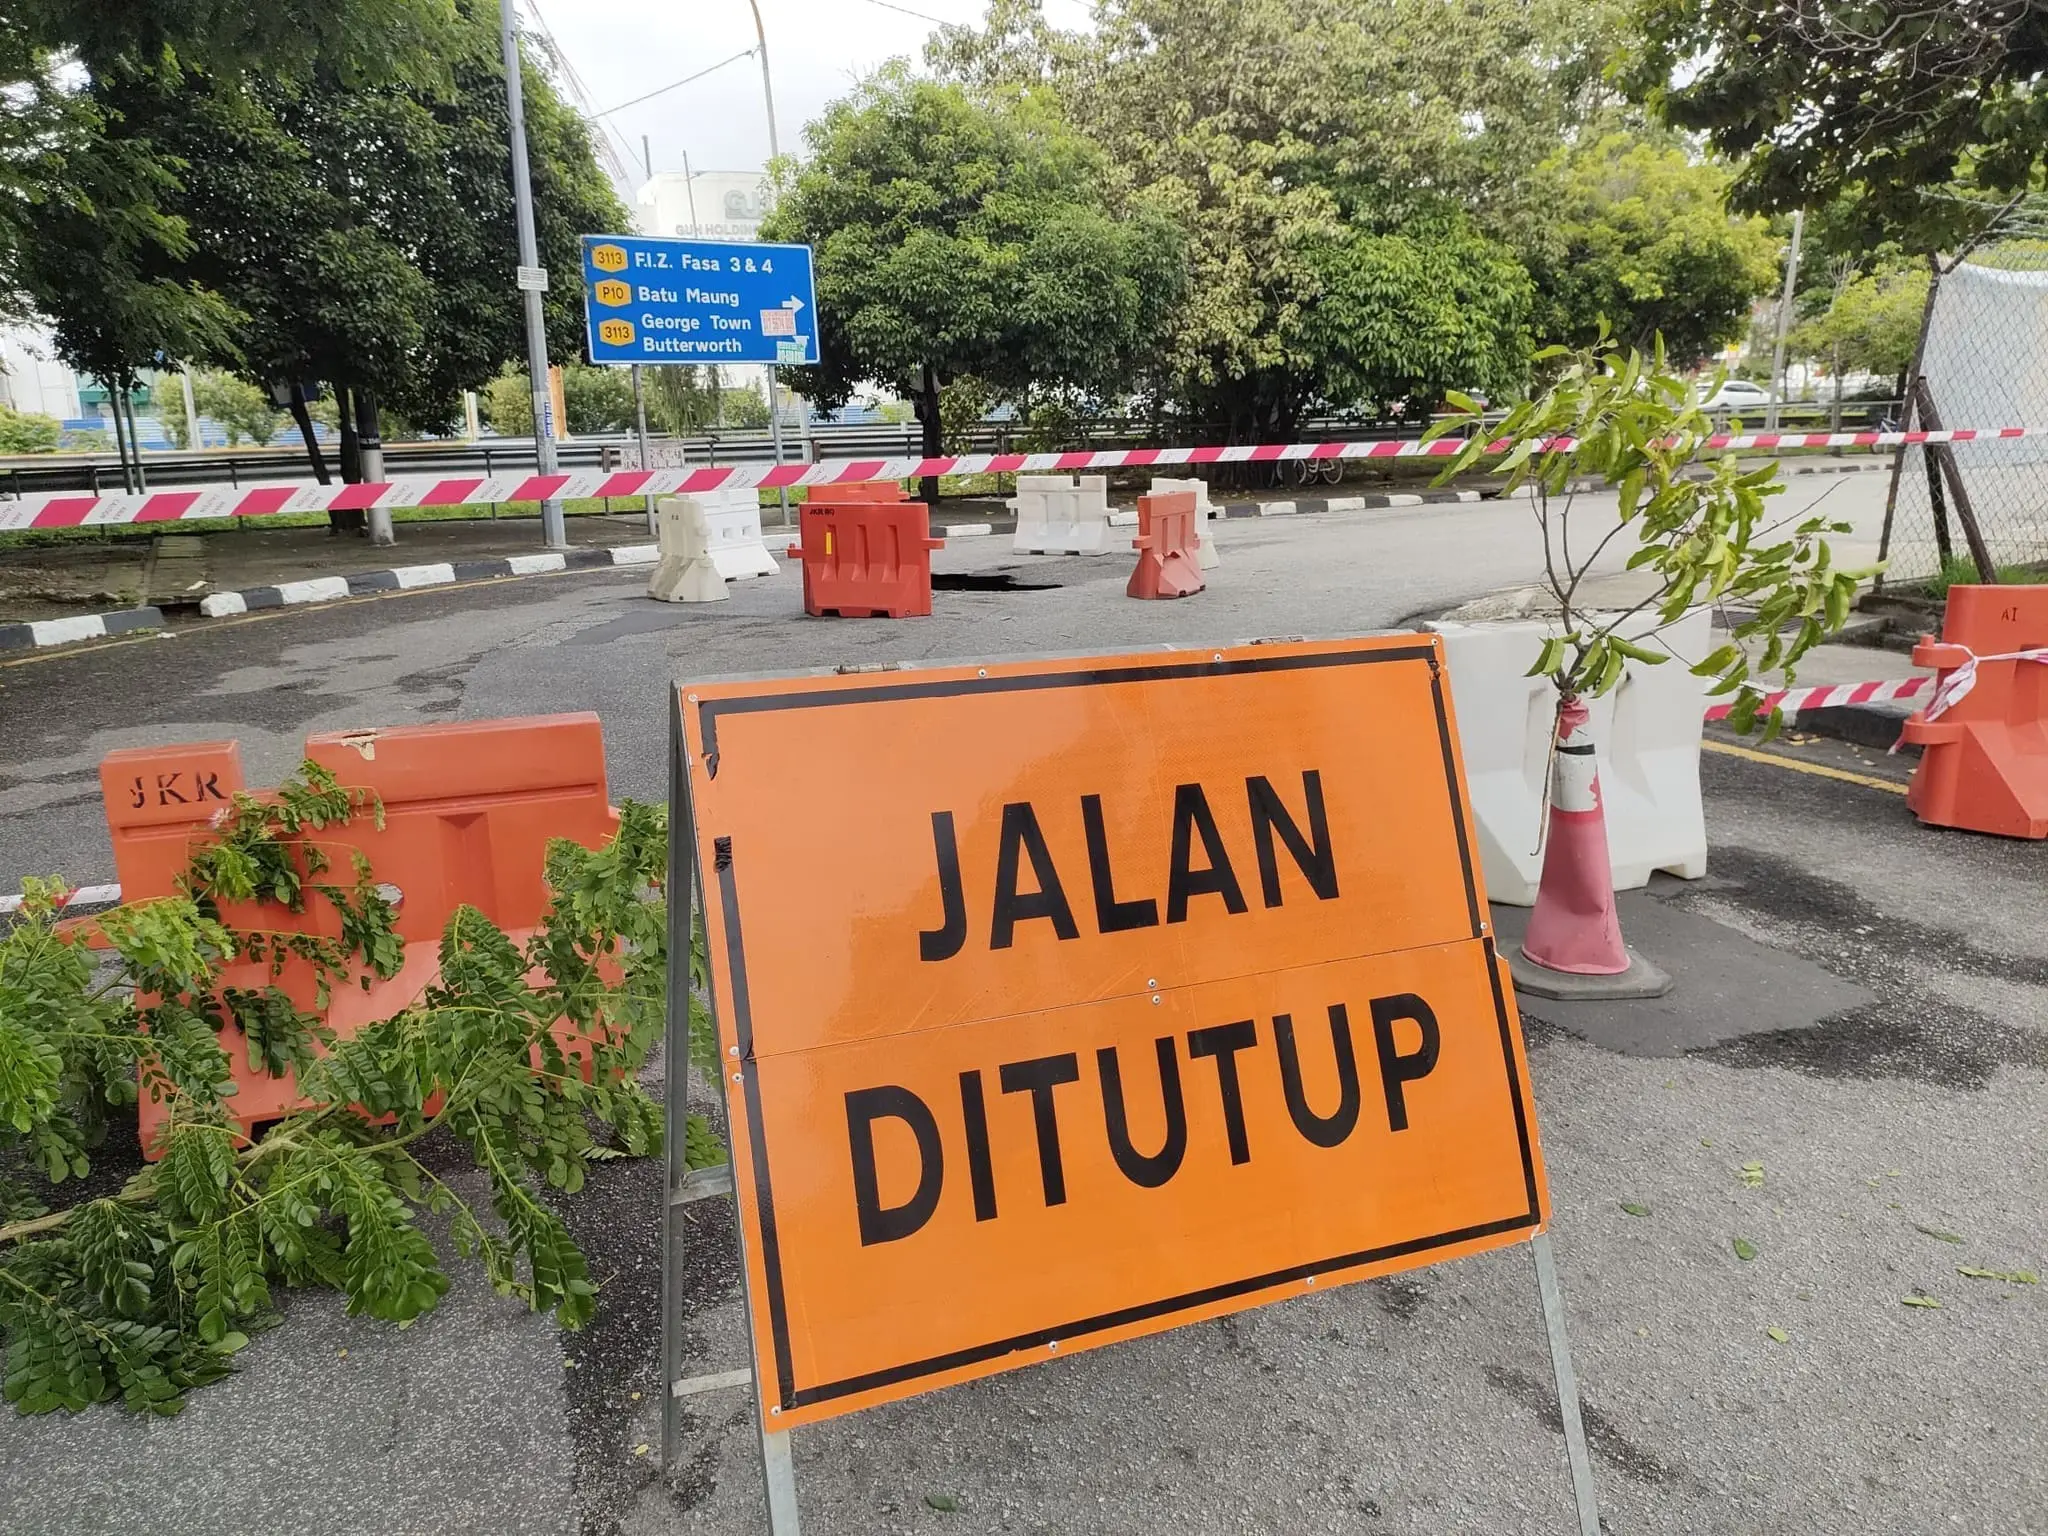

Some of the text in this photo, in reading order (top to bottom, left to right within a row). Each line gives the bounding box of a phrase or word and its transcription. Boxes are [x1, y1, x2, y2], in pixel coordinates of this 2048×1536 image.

[598, 251, 623, 265] 3113
[634, 252, 773, 274] F.I.Z. Fasa 3 & 4
[602, 286, 624, 300] P10
[638, 286, 739, 307] Batu Maung
[604, 326, 630, 339] 3113
[642, 313, 700, 333] George
[710, 315, 752, 330] Town
[643, 337, 742, 353] Butterworth
[129, 771, 228, 809] JKR
[918, 768, 1341, 963] JALAN
[843, 992, 1442, 1248] DITUTUP
